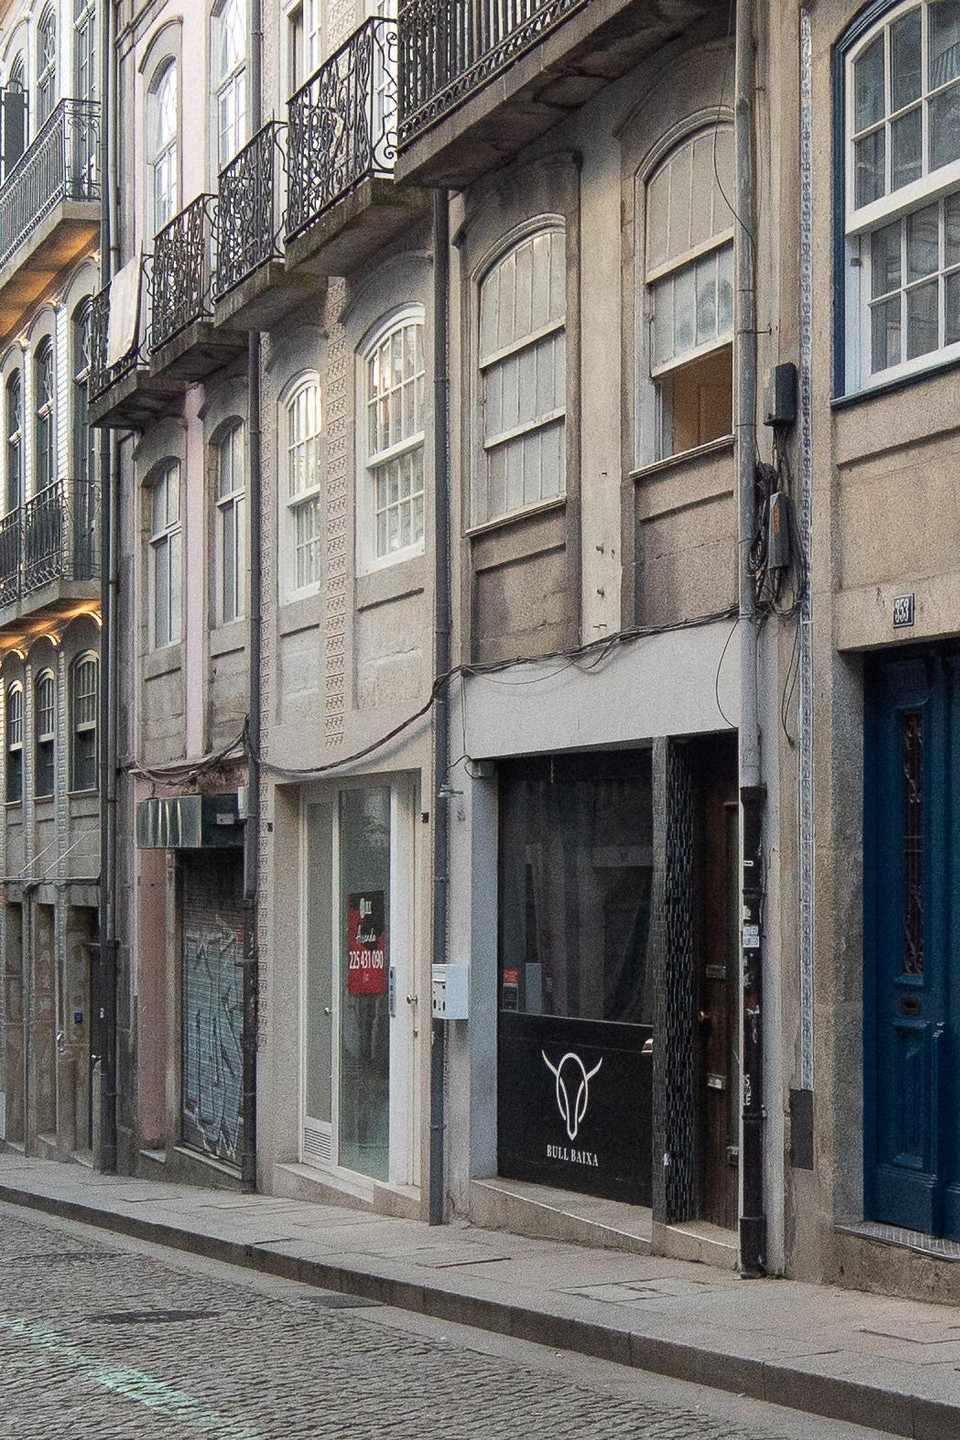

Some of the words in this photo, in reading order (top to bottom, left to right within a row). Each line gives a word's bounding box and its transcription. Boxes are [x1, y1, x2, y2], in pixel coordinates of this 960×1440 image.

[895, 598, 909, 623] 353
[349, 950, 360, 969] 225
[546, 1144, 569, 1161] BULL
[570, 1149, 599, 1167] BAIXA
